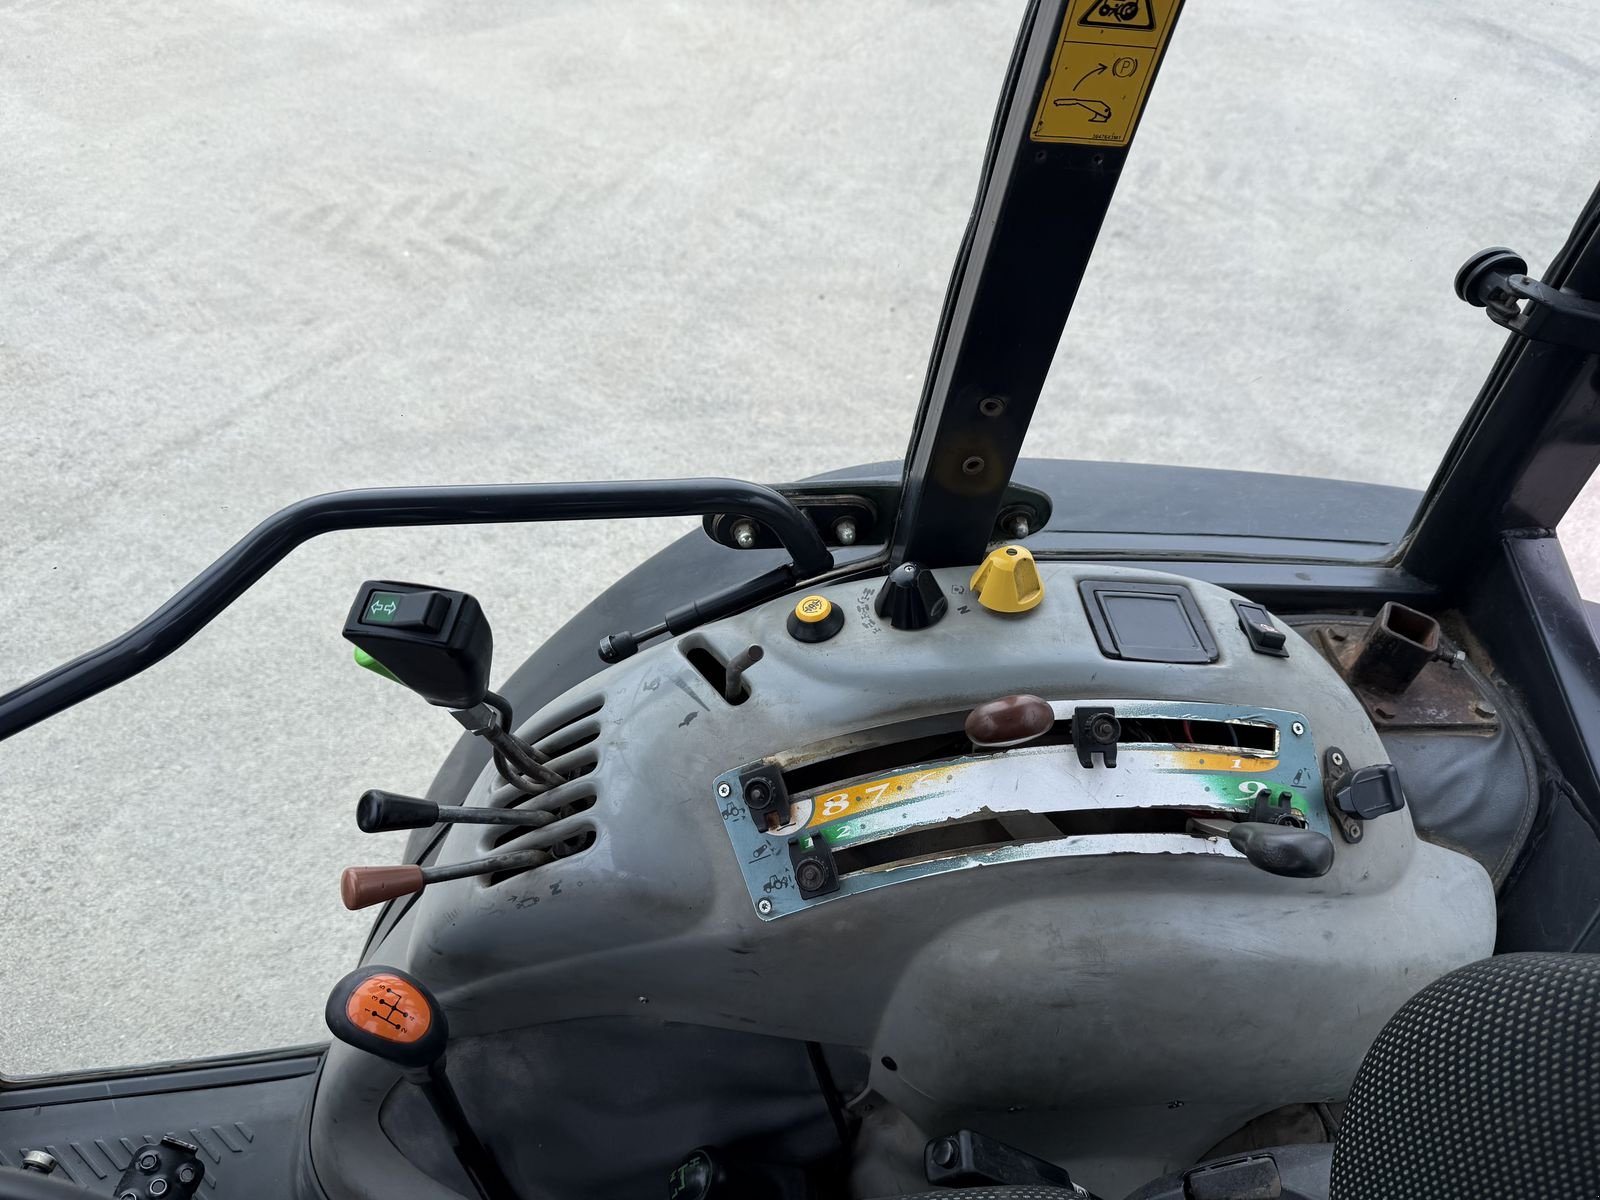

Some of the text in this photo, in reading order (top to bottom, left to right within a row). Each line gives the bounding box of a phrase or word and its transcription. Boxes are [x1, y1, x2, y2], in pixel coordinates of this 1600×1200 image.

[1230, 759, 1242, 769] 1
[823, 782, 891, 816] 8 7
[1234, 780, 1268, 801] 9
[836, 826, 851, 839] 2
